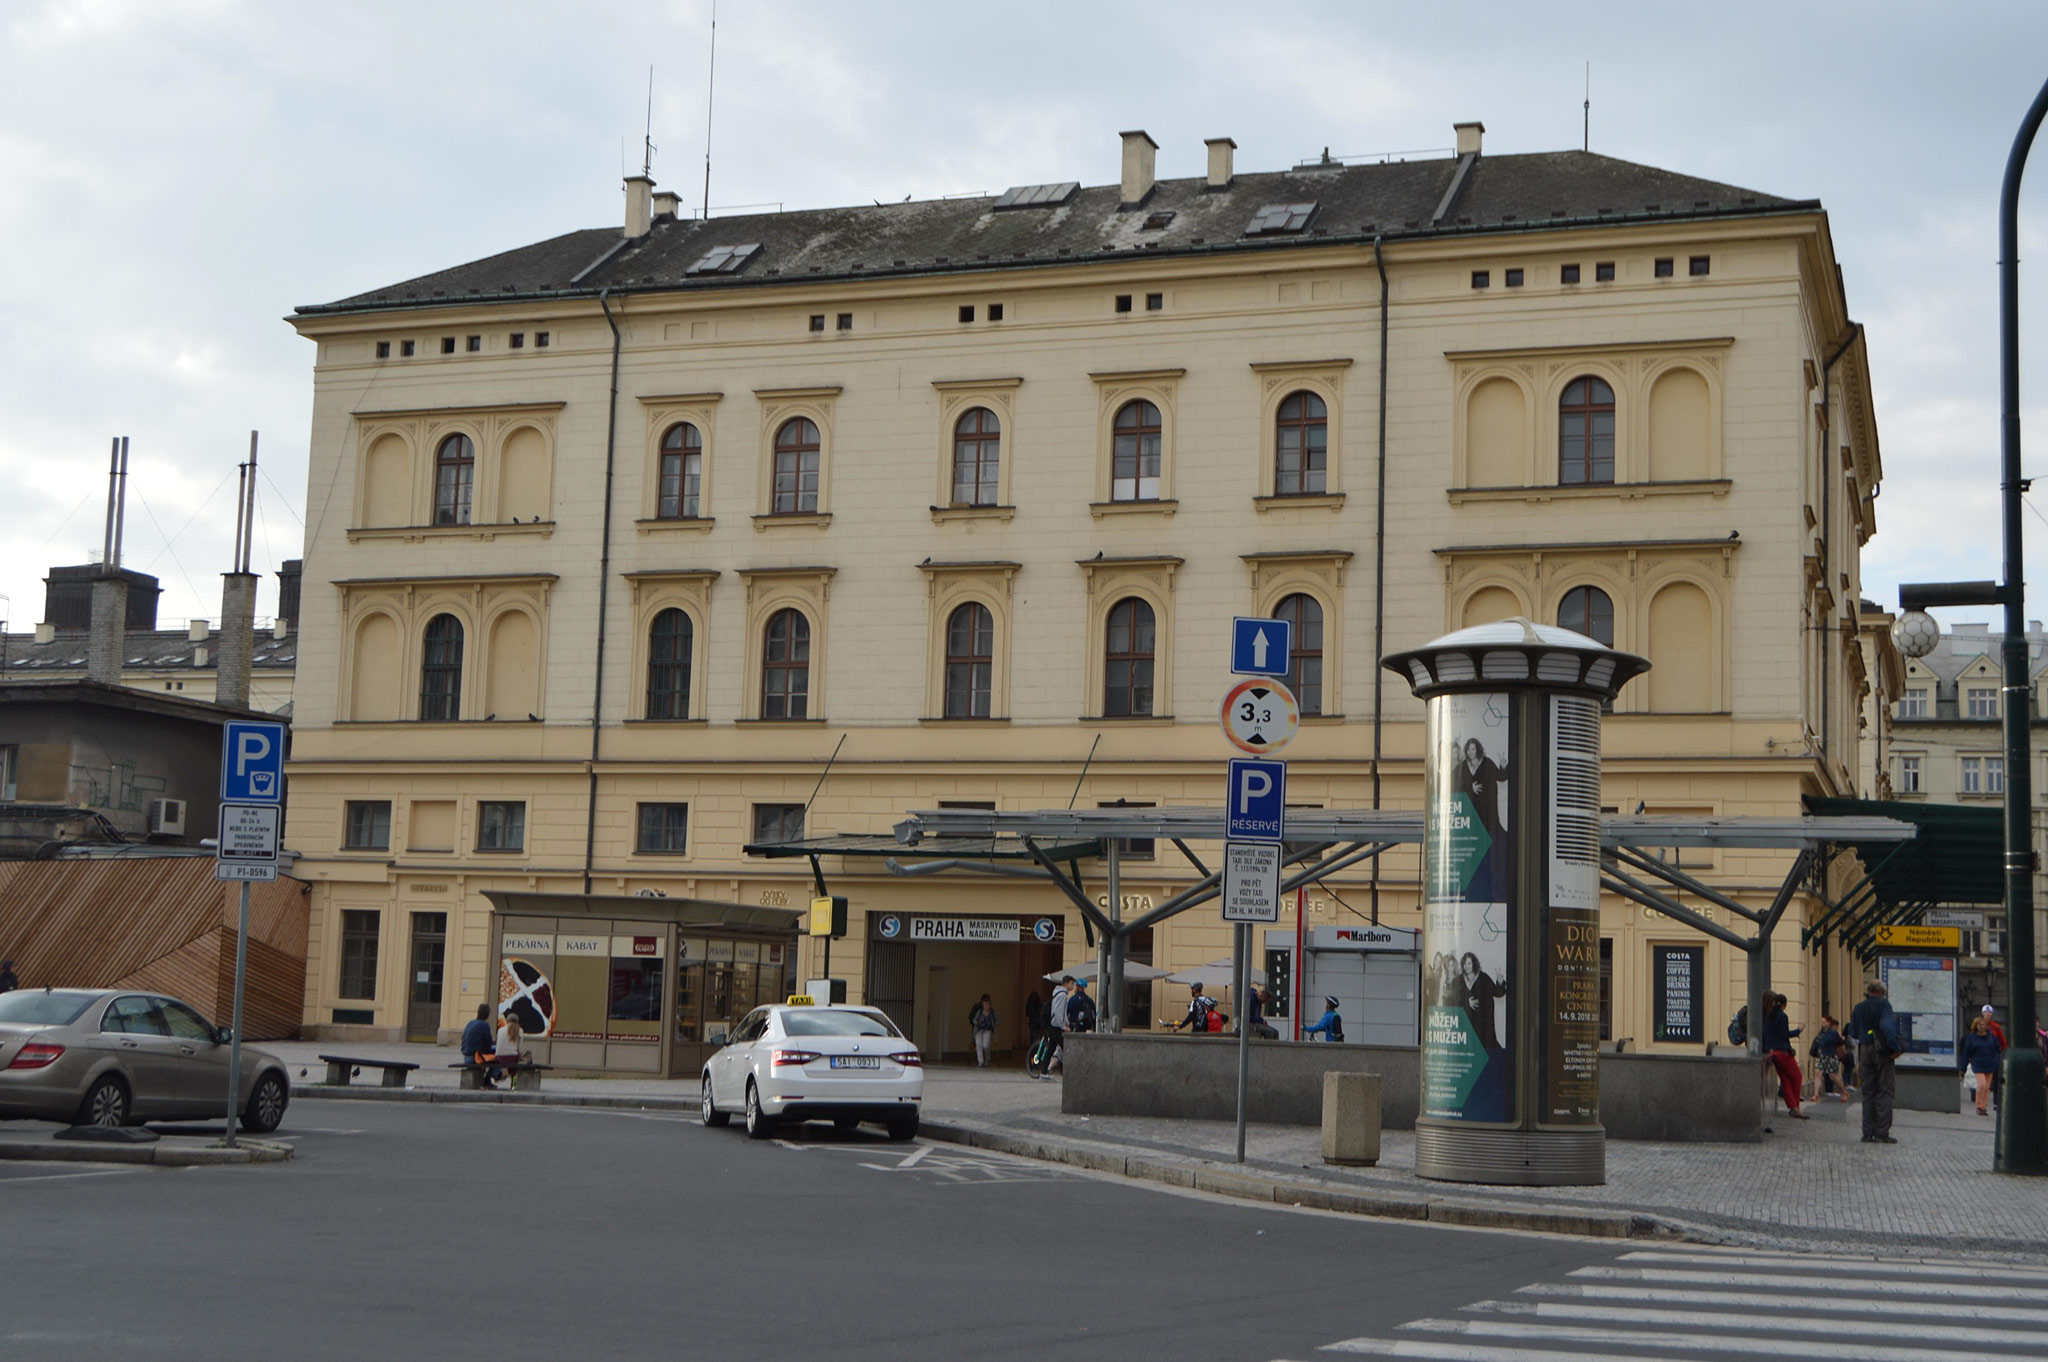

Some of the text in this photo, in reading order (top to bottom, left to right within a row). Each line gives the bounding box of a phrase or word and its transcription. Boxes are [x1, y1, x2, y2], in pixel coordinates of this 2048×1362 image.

[1240, 702, 1271, 724] 3,3
[237, 732, 270, 776] P
[1240, 769, 1272, 814] P
[1232, 818, 1278, 832] RÉSERVÉ
[1230, 848, 1256, 857] STANOVIŠTĚ
[238, 867, 267, 876] P1-0596
[1252, 879, 1262, 887] PĚT
[1098, 895, 1152, 910] CSTA
[915, 920, 1018, 937] PRAHA MASARYKOVO
[1350, 931, 1391, 942] Marlboro
[1906, 936, 1946, 944] Republiky
[506, 938, 597, 950] PEKÁRNA KABÁT
[792, 996, 812, 1005] TAXI
[1433, 1028, 1467, 1045] MUŽEM
